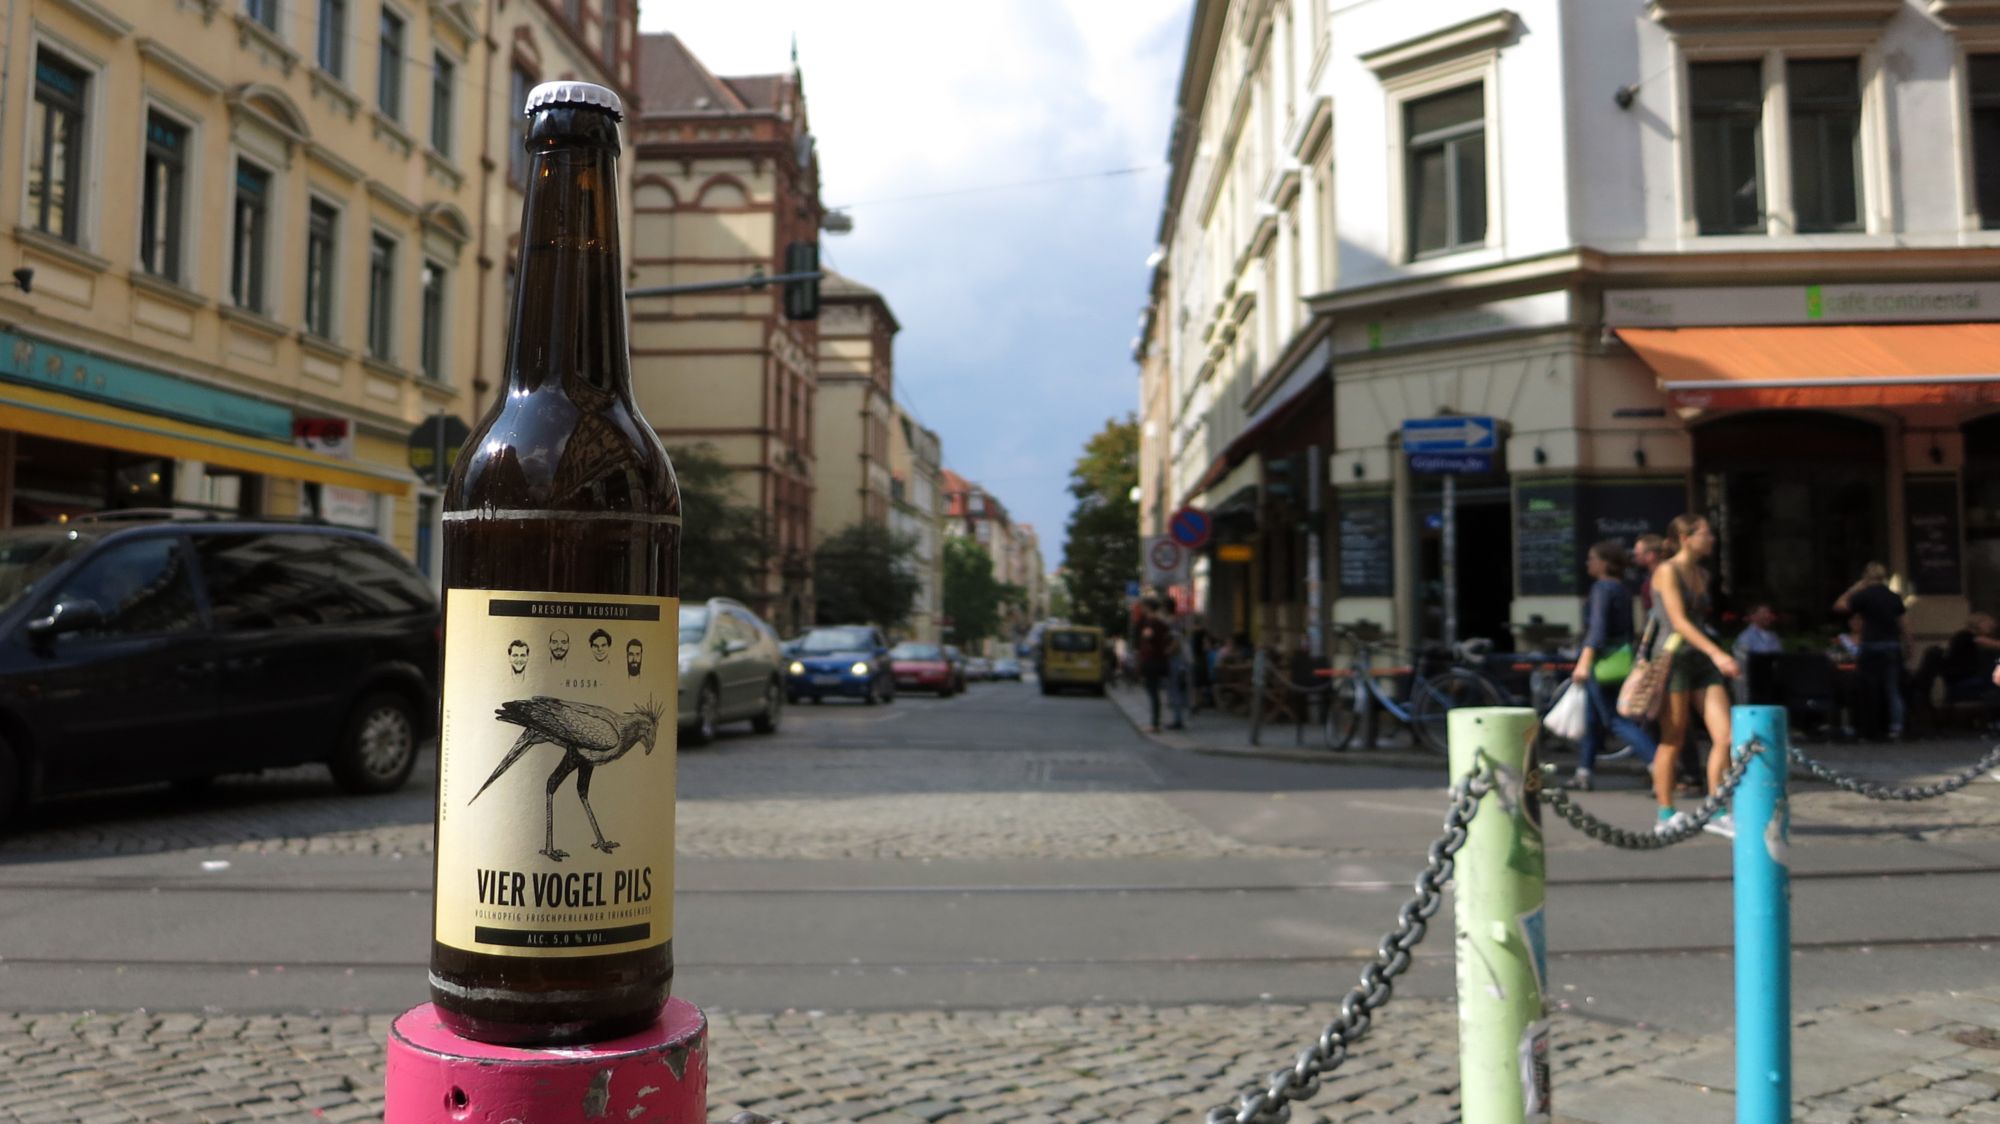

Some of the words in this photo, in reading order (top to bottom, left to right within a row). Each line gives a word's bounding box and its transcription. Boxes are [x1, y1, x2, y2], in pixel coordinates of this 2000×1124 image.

[531, 604, 574, 615] DRESDEN
[587, 606, 629, 617] NEUSTADT
[477, 868, 526, 907] VIER
[532, 871, 606, 908] VOGEL
[613, 866, 652, 905] PILS
[475, 909, 521, 922] VOLLHOPFIG
[526, 911, 604, 923] FRISCHPERLENDER
[608, 906, 652, 920] TRINKGENUSS
[527, 933, 548, 944] ALC.
